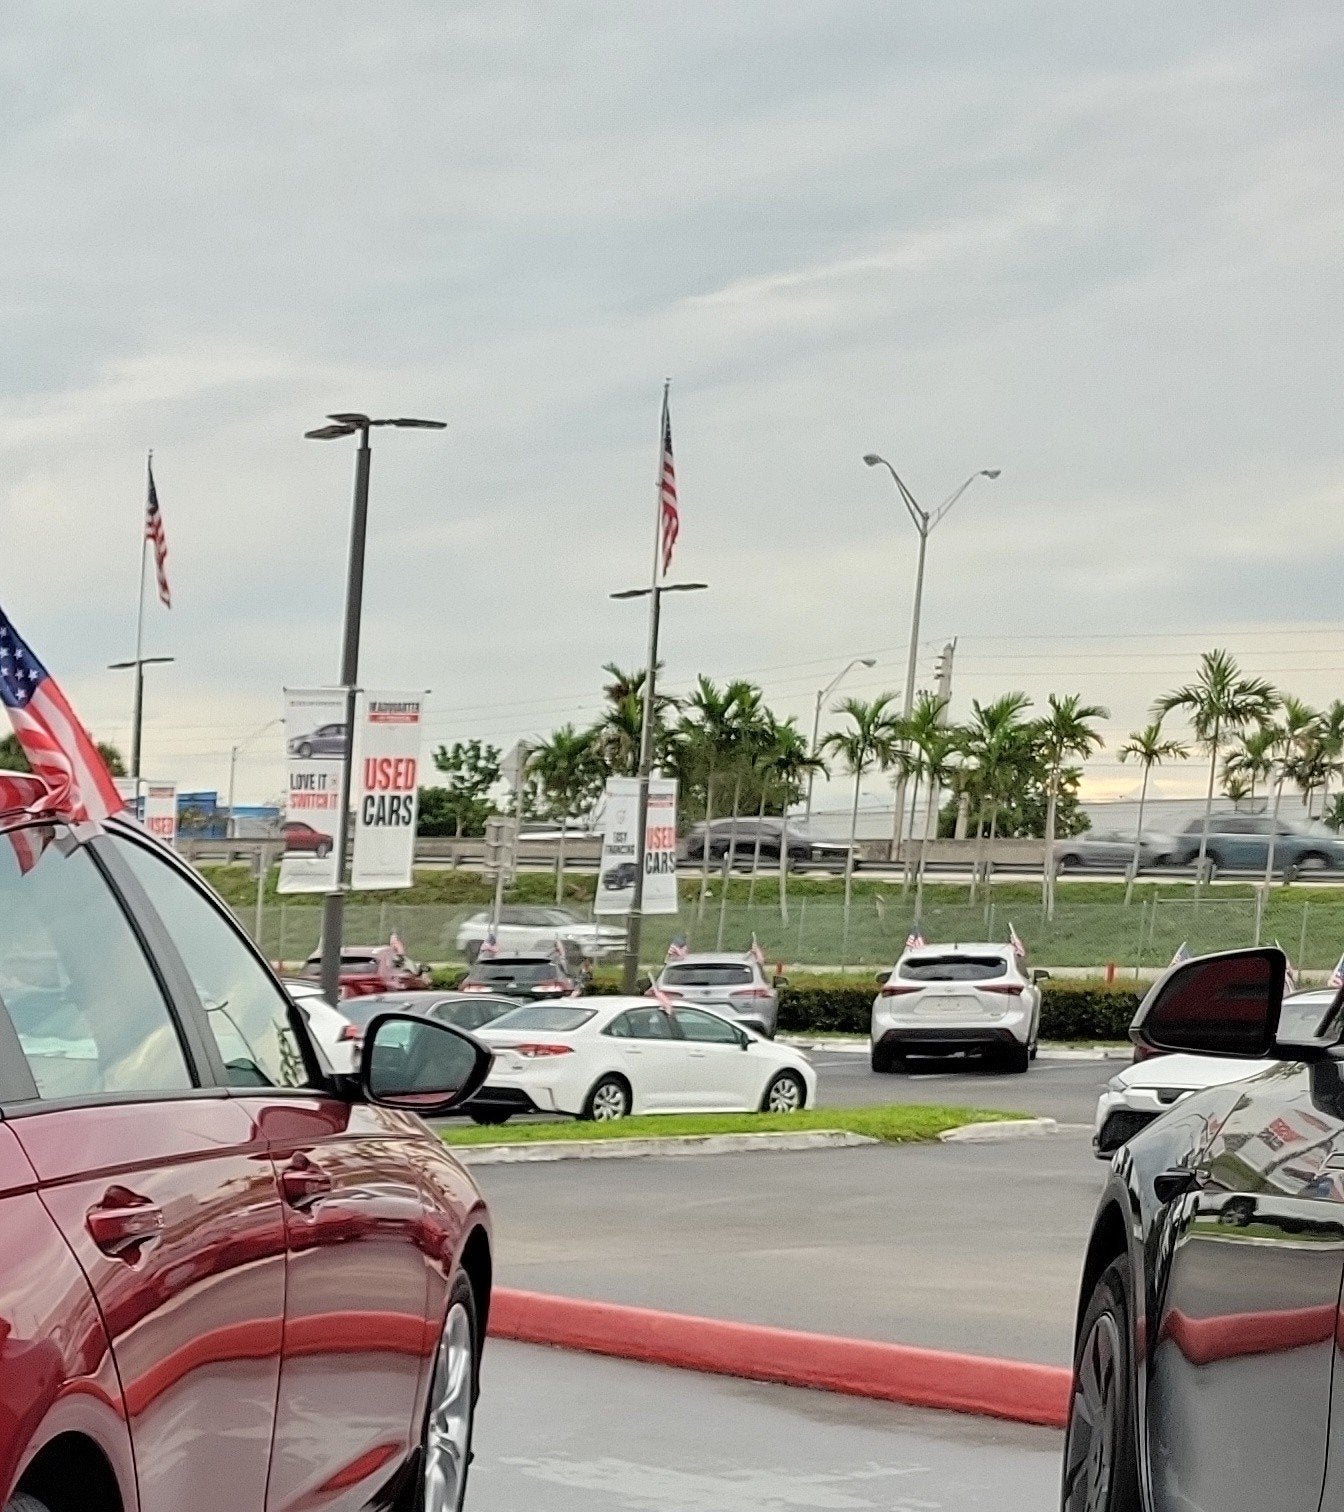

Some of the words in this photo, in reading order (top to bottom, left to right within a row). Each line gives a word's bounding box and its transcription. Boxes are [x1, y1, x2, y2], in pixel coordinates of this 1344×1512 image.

[290, 773, 315, 791] LOVE
[318, 773, 327, 790] IT
[365, 757, 416, 791] USED
[290, 793, 328, 809] SWITCH
[330, 793, 338, 810] IT
[363, 794, 413, 826] CARS
[646, 827, 676, 850] USED
[645, 852, 675, 875] CARS
